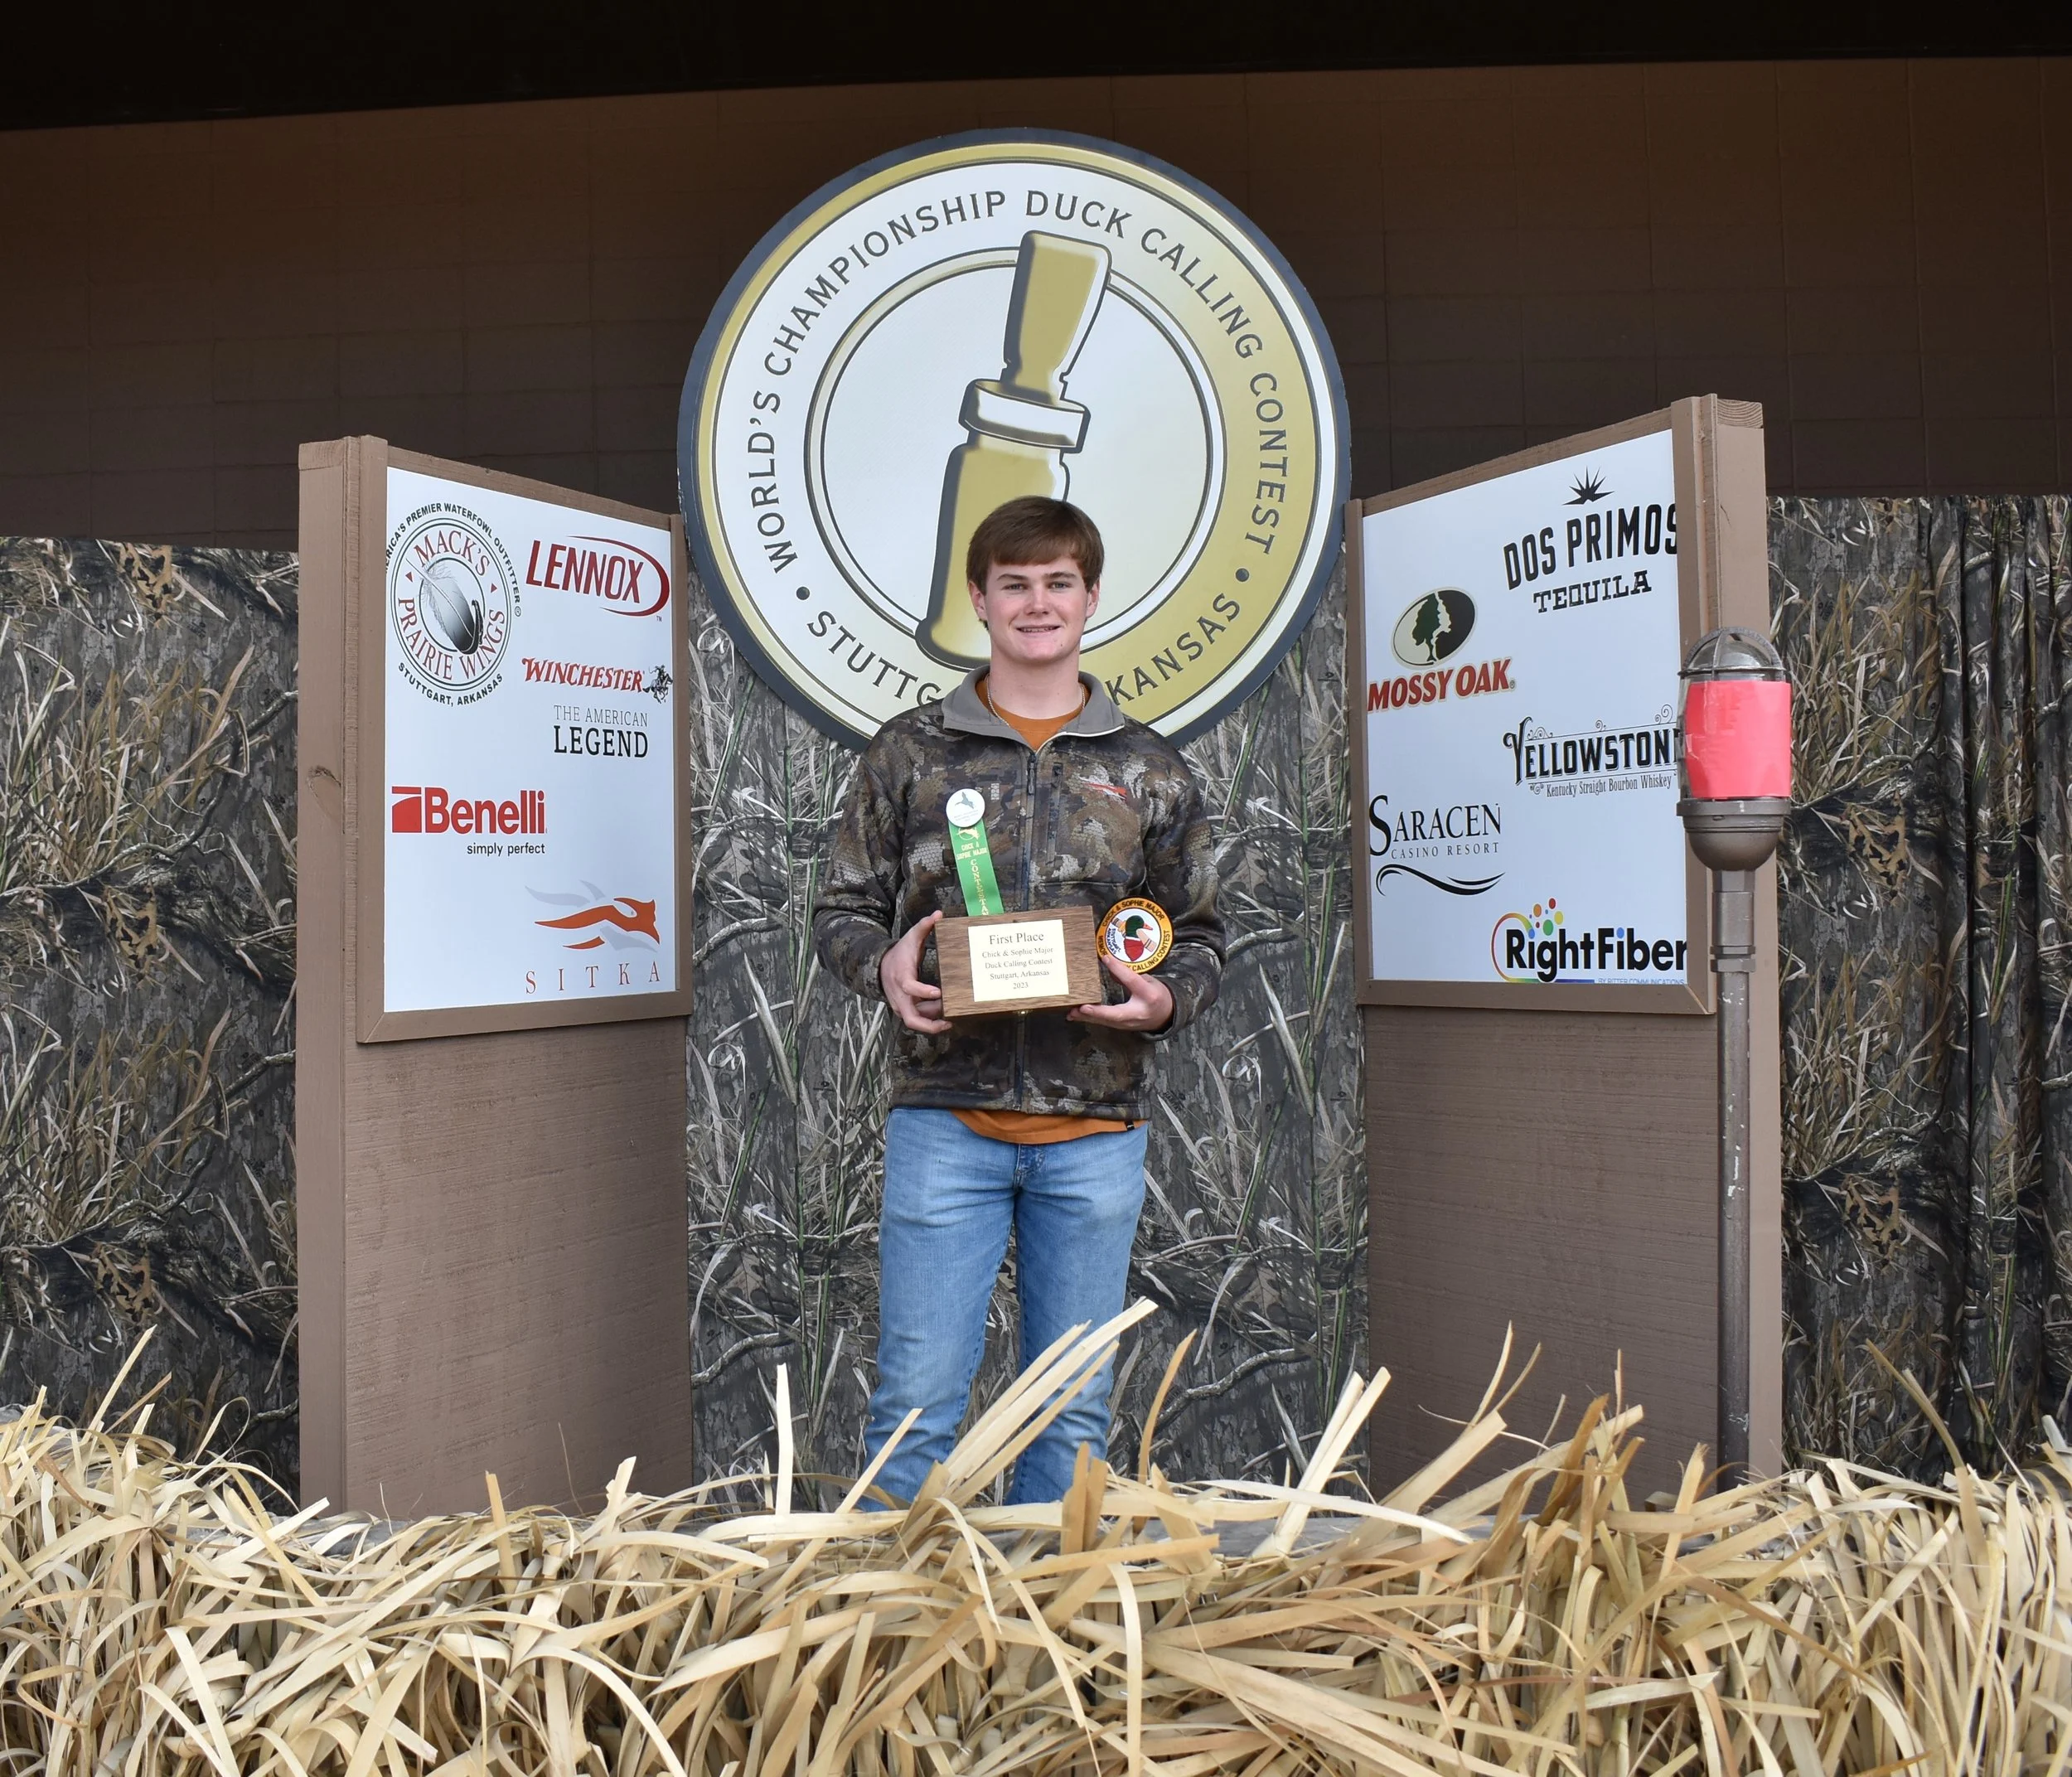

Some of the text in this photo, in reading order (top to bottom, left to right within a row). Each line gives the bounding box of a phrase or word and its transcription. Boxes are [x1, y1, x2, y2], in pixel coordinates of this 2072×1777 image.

[748, 190, 1288, 574] WORLD'S CHAMPIONSHIP DUCK CALLING CONTEST
[385, 502, 520, 603] ERICA'S PREMIER WATERFOWL OUTFITTER
[414, 530, 490, 576] MACK'S
[1503, 503, 1677, 591] DOS PRIMOS
[525, 540, 644, 604] LENNOX
[1533, 569, 1652, 613] TEQUILA
[398, 598, 505, 680] PRAIRIE WINGS
[806, 593, 1240, 706] STUTTG KANSAS
[399, 662, 503, 707] STUTTGART, ARKANSAS
[521, 657, 642, 693] WINCHESTER
[1368, 658, 1510, 712] MOSSY OAK
[554, 705, 648, 727] THE AMERICAN
[554, 725, 648, 758] LEGEND
[1547, 774, 1672, 797] Kentucky Straight Bourbon Whiskey
[424, 787, 545, 835] Benelli
[1368, 795, 1501, 856] SARACEN
[467, 842, 545, 857] simply perfect
[1391, 842, 1498, 859] CASINO RESORT
[971, 859, 989, 915] CONTESTAN
[1145, 903, 1164, 920] MAJOR
[989, 932, 1044, 945] First Place
[1010, 948, 1033, 957] Sophie
[1132, 956, 1159, 971] CALLING
[1156, 930, 1170, 957] CONTEST
[1506, 927, 1687, 982] RightFiber
[990, 971, 1019, 980] Stuttgart,
[1004, 960, 1027, 968] Calling
[1013, 981, 1029, 990] 2023
